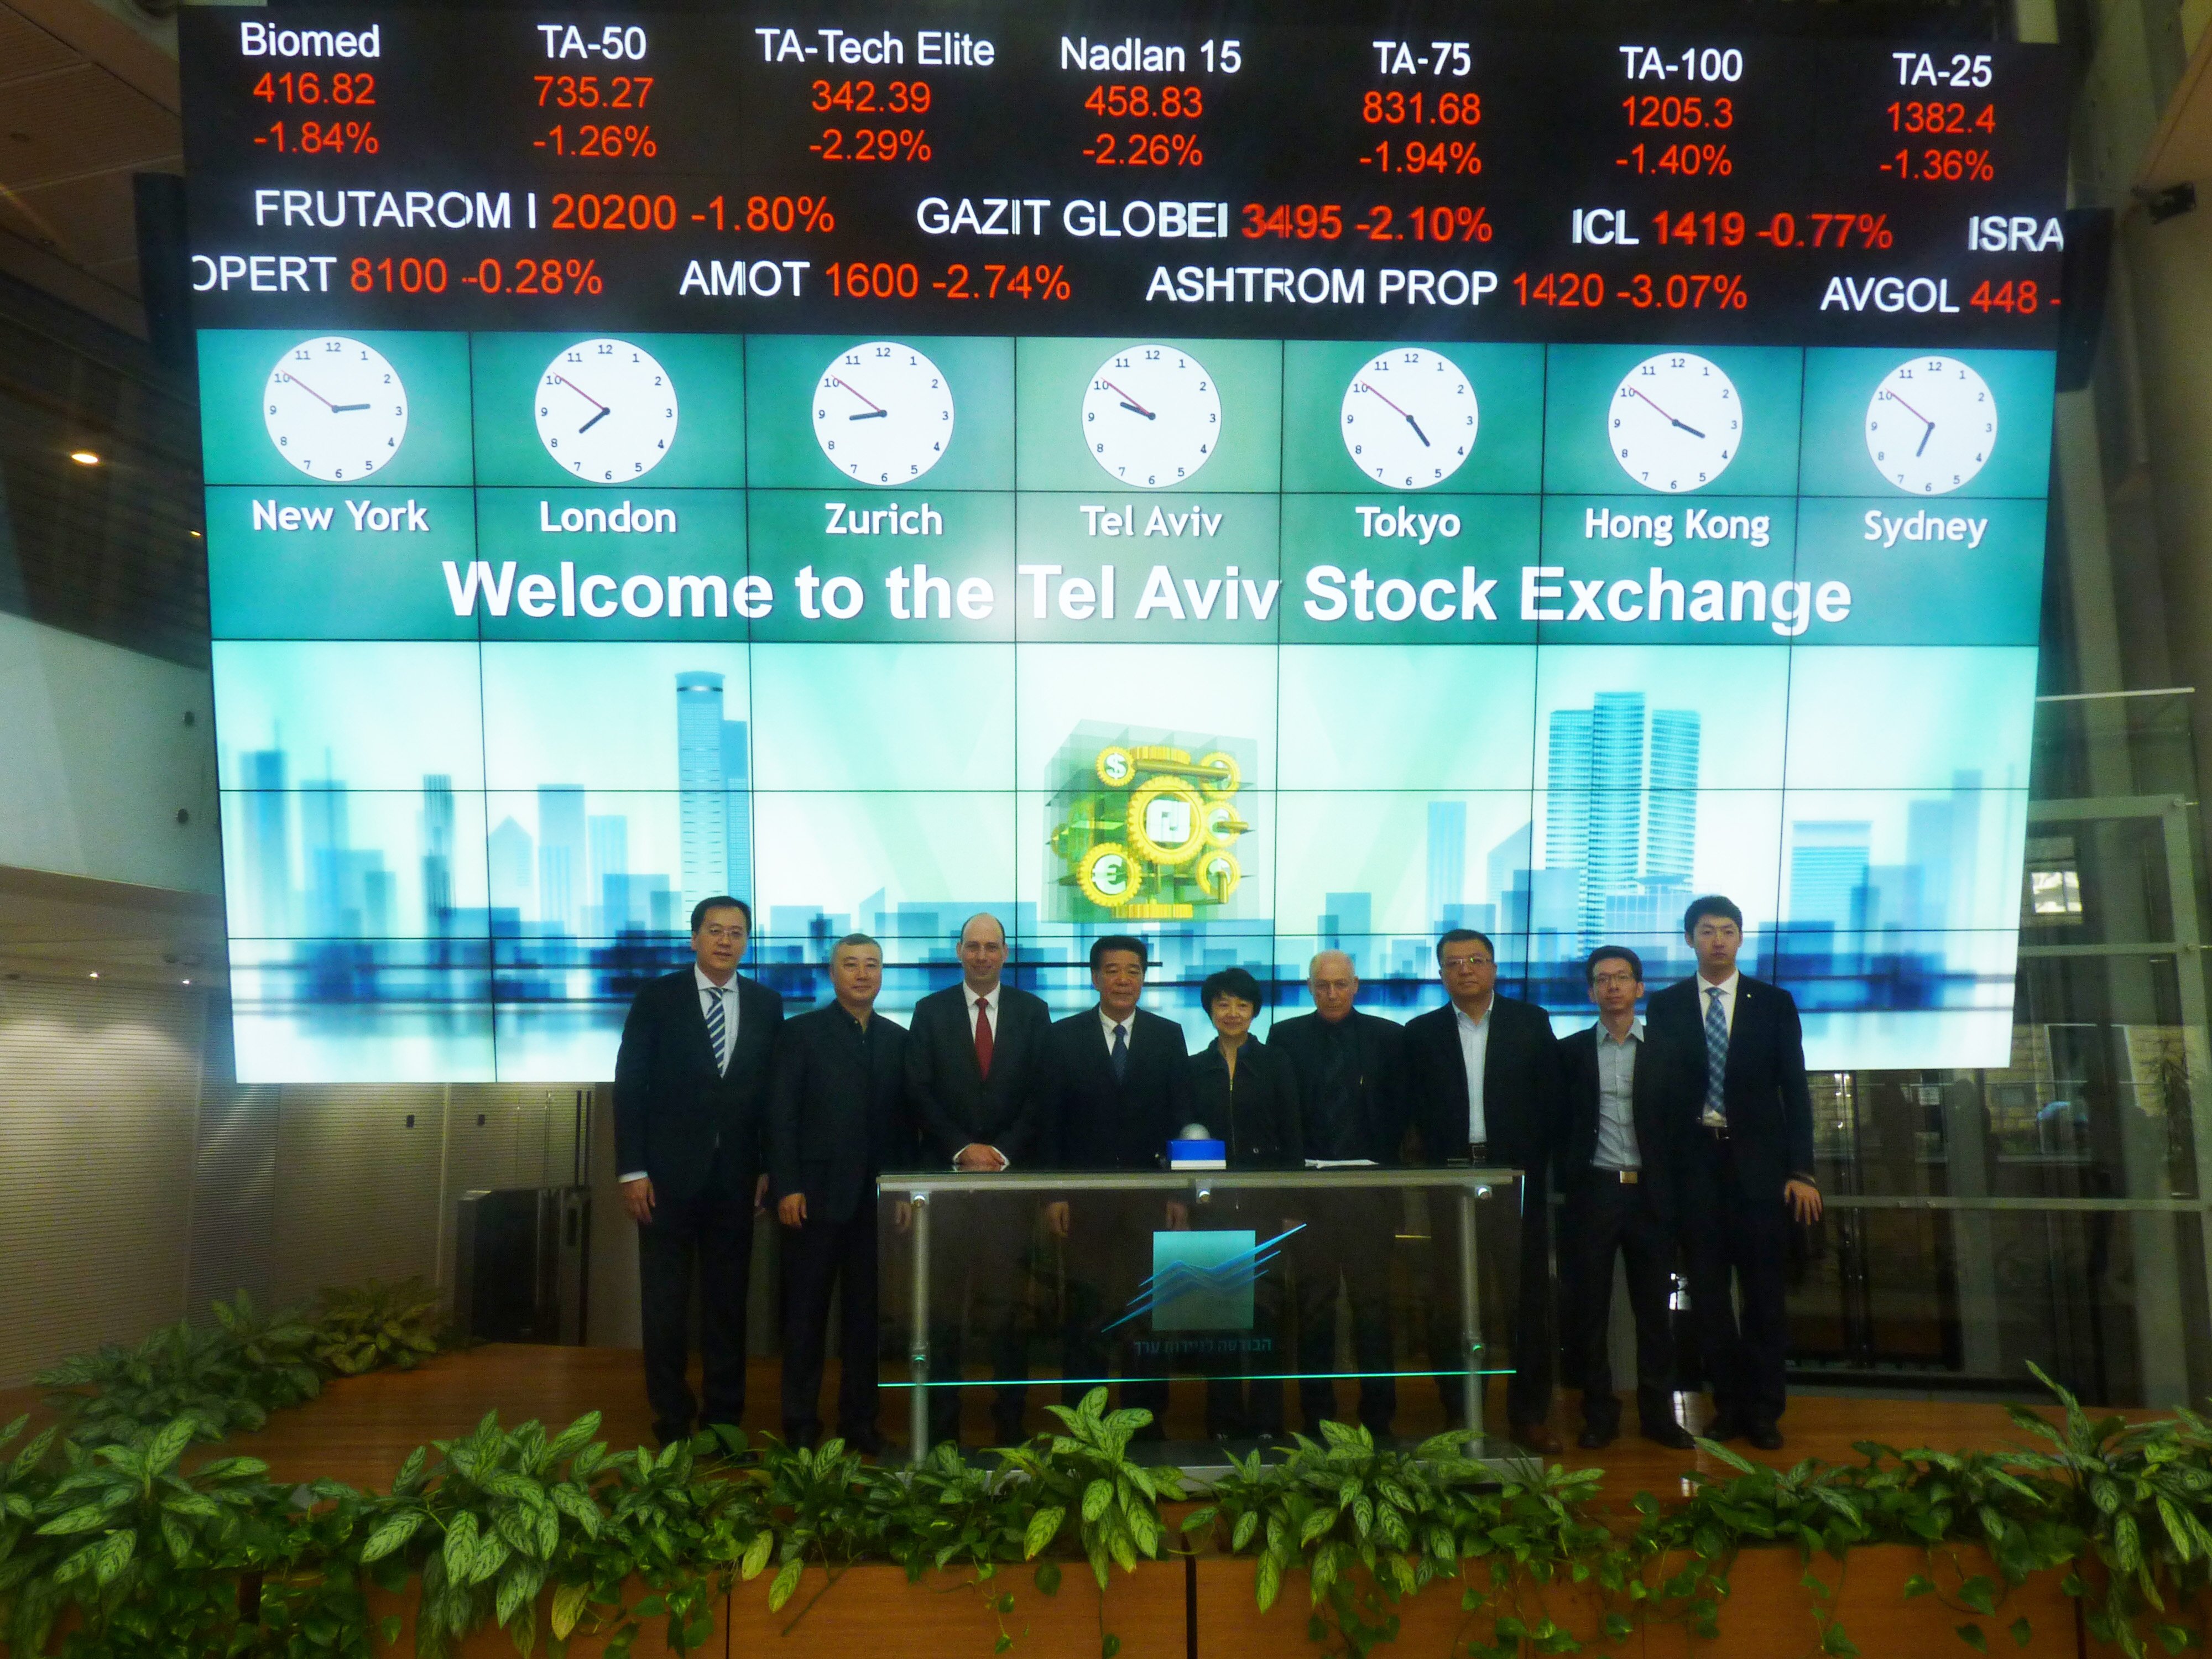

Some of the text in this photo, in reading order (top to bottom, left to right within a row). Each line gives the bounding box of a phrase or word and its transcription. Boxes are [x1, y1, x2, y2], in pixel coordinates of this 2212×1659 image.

[241, 22, 379, 58] Biomed
[538, 25, 646, 60] TA-50
[755, 29, 994, 66] TA-Tech Elite
[1062, 36, 1241, 73] Nadlan 15
[1373, 41, 1470, 76] TA-75
[1620, 46, 1743, 81] TA-100
[1892, 53, 1992, 87] TA-25
[253, 72, 375, 105] 416.82
[534, 75, 654, 108] 735.27
[812, 80, 931, 113] 342.39
[1085, 85, 1203, 118] 458.83
[1363, 91, 1481, 126] 831.68
[1623, 96, 1733, 129] 1205.3
[1888, 102, 1995, 133] 1382.4
[254, 121, 379, 154] -1.84%
[534, 124, 657, 158] -1.26%
[810, 128, 932, 161] -2.29%
[1083, 133, 1203, 166] -2.26%
[1360, 140, 1482, 175] -1.94%
[1616, 143, 1732, 176] -1.40%
[1880, 149, 1994, 181] -1.36%
[255, 190, 510, 228] FRUTAROM
[528, 193, 535, 228] I
[552, 193, 677, 231] 20200
[692, 195, 835, 233] -1.80%
[917, 197, 1051, 235] GAZIT
[1243, 204, 1343, 239] 3495
[1356, 205, 1493, 242] -2.10%
[1573, 209, 1639, 244] ICL
[1653, 211, 1745, 247] 1419
[1757, 212, 1892, 249] -0.77%
[1969, 216, 2063, 252] ISRA
[351, 258, 447, 293] 8100
[462, 258, 603, 294] -0.28%
[680, 260, 810, 296] AMOT
[826, 262, 919, 298] 1600
[932, 264, 1071, 300] -2.74%
[1146, 267, 1364, 303] ASHTROM
[1380, 269, 1498, 305] PROP
[1514, 273, 1604, 307] 1420
[1618, 274, 1747, 309] -3.07%
[1820, 277, 1959, 312] AVGOL
[1970, 280, 2037, 314] 448
[326, 342, 341, 352] 12
[597, 344, 613, 354] 12
[295, 350, 311, 361] 11
[361, 351, 369, 361] 1
[567, 352, 583, 363] 11
[875, 347, 891, 358] 12
[1145, 349, 1160, 361] 12
[632, 353, 640, 363] 1
[845, 355, 861, 366] 11
[910, 356, 917, 366] 1
[1115, 358, 1130, 368] 11
[1404, 353, 1419, 363] 12
[1671, 358, 1686, 368] 12
[1178, 358, 1186, 369] 1
[1374, 361, 1390, 371] 11
[1437, 362, 1444, 372] 1
[1928, 361, 1942, 372] 12
[1641, 366, 1656, 376] 11
[1703, 367, 1710, 377] 1
[1899, 369, 1913, 379] 11
[1959, 370, 1966, 380] 1
[274, 373, 290, 383] 10
[384, 373, 391, 384] 2
[546, 375, 562, 385] 10
[654, 375, 662, 387] 2
[824, 377, 839, 388] 10
[931, 378, 938, 389] 2
[1094, 380, 1109, 390] 10
[1199, 381, 1207, 392] 2
[1353, 383, 1369, 393] 10
[1457, 384, 1464, 394] 2
[1620, 388, 1636, 398] 10
[1722, 389, 1729, 399] 2
[1877, 391, 1892, 401] 10
[1978, 392, 1985, 402] 2
[269, 405, 277, 415] 9
[395, 406, 403, 416] 3
[540, 406, 549, 417] 9
[665, 408, 673, 418] 3
[818, 409, 826, 419] 9
[942, 410, 949, 421] 3
[1088, 412, 1095, 422] 9
[1209, 413, 1216, 423] 3
[1347, 414, 1354, 424] 9
[1466, 415, 1474, 426] 3
[1614, 418, 1621, 429] 9
[1731, 420, 1738, 430] 3
[1871, 421, 1878, 431] 9
[1985, 422, 1992, 433] 3
[280, 436, 288, 446] 8
[387, 437, 395, 447] 4
[551, 438, 558, 448] 8
[657, 439, 665, 449] 4
[827, 440, 835, 450] 8
[933, 441, 940, 452] 4
[1097, 443, 1104, 453] 8
[1200, 444, 1207, 454] 4
[1355, 445, 1362, 455] 8
[1457, 446, 1464, 456] 4
[1621, 448, 1628, 458] 8
[1721, 450, 1728, 460] 4
[1877, 451, 1885, 461] 8
[1975, 452, 1983, 463] 4
[304, 460, 311, 470] 7
[365, 460, 373, 471] 5
[573, 461, 581, 472] 7
[634, 462, 643, 472] 5
[850, 464, 858, 474] 7
[911, 465, 918, 474] 5
[335, 468, 342, 479] 6
[604, 470, 612, 481] 6
[1118, 467, 1125, 477] 7
[1177, 467, 1185, 477] 5
[1376, 468, 1384, 478] 7
[1434, 468, 1442, 478] 5
[1642, 472, 1649, 482] 7
[1699, 472, 1707, 482] 5
[880, 472, 888, 483] 6
[1148, 475, 1155, 485] 6
[1405, 476, 1412, 486] 6
[1897, 474, 1905, 484] 7
[1953, 474, 1960, 484] 5
[1670, 480, 1677, 490] 6
[1924, 482, 1932, 492] 6
[253, 500, 429, 531] New York
[541, 502, 676, 533] London
[826, 503, 942, 535] Zurich
[1080, 505, 1222, 537] Tel Aviv
[1356, 507, 1460, 545] Tokyo
[1586, 509, 1769, 547] Hong Kong
[1865, 510, 1987, 547] Sydney
[443, 561, 1851, 636] Welcome to the Tel Aviv Stock Exchange
